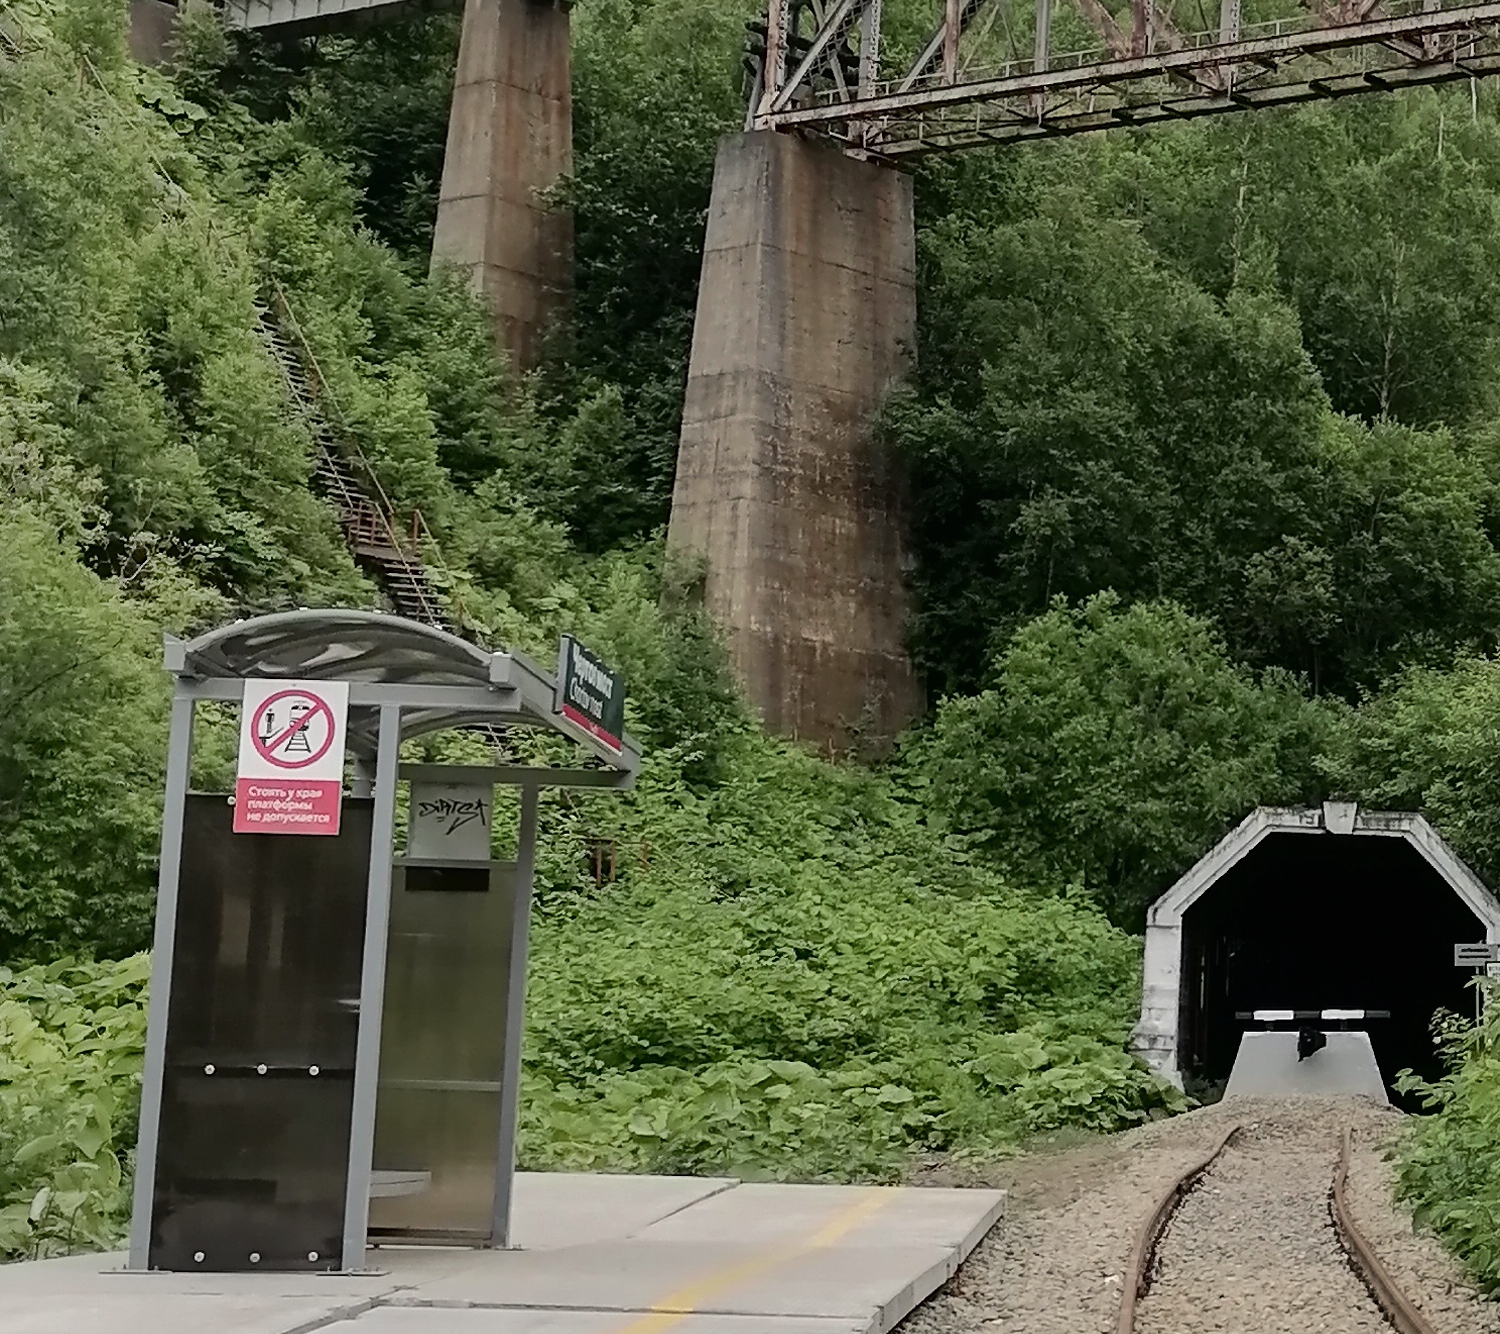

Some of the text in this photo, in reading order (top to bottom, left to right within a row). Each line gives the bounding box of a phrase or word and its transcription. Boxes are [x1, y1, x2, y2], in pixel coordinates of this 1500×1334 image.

[248, 786, 323, 801] Стоять у края
[247, 799, 313, 812] платформы
[246, 812, 331, 824] не допускается
